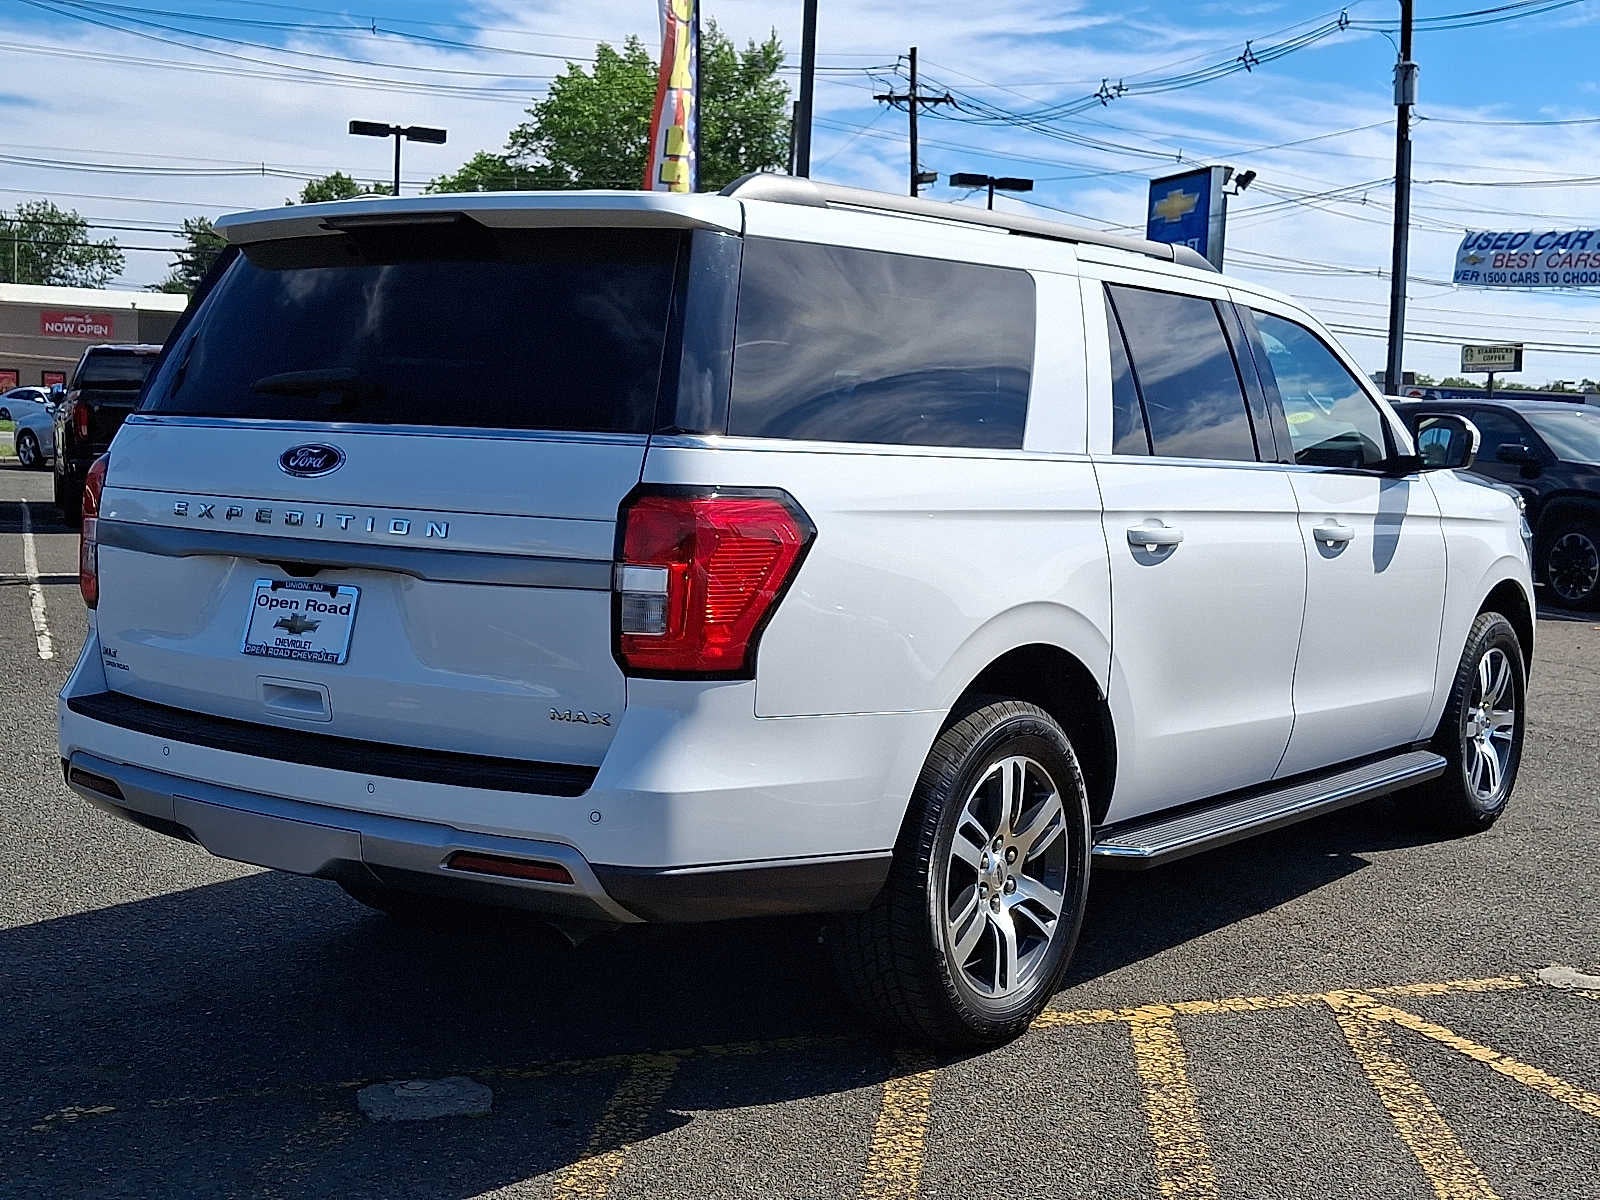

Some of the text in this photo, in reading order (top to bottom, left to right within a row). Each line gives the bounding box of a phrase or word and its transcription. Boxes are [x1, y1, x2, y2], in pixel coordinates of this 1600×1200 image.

[1463, 231, 1530, 250] USED
[1533, 231, 1594, 250] CAR
[1492, 252, 1600, 269] BEST CARS
[1483, 271, 1507, 283] 1500
[1509, 271, 1540, 284] CARS
[1543, 271, 1559, 284] TO
[1562, 271, 1600, 284] CHOO
[45, 322, 108, 335] NOW OPEN
[289, 449, 328, 469] Ford
[173, 501, 450, 539] EXPEDITION
[312, 584, 323, 592] NJ
[257, 594, 351, 616] Open Road
[245, 643, 338, 663] OPEN ROAD CHEVROLET
[274, 637, 312, 650] CHEVROLET
[550, 707, 612, 726] MAX
